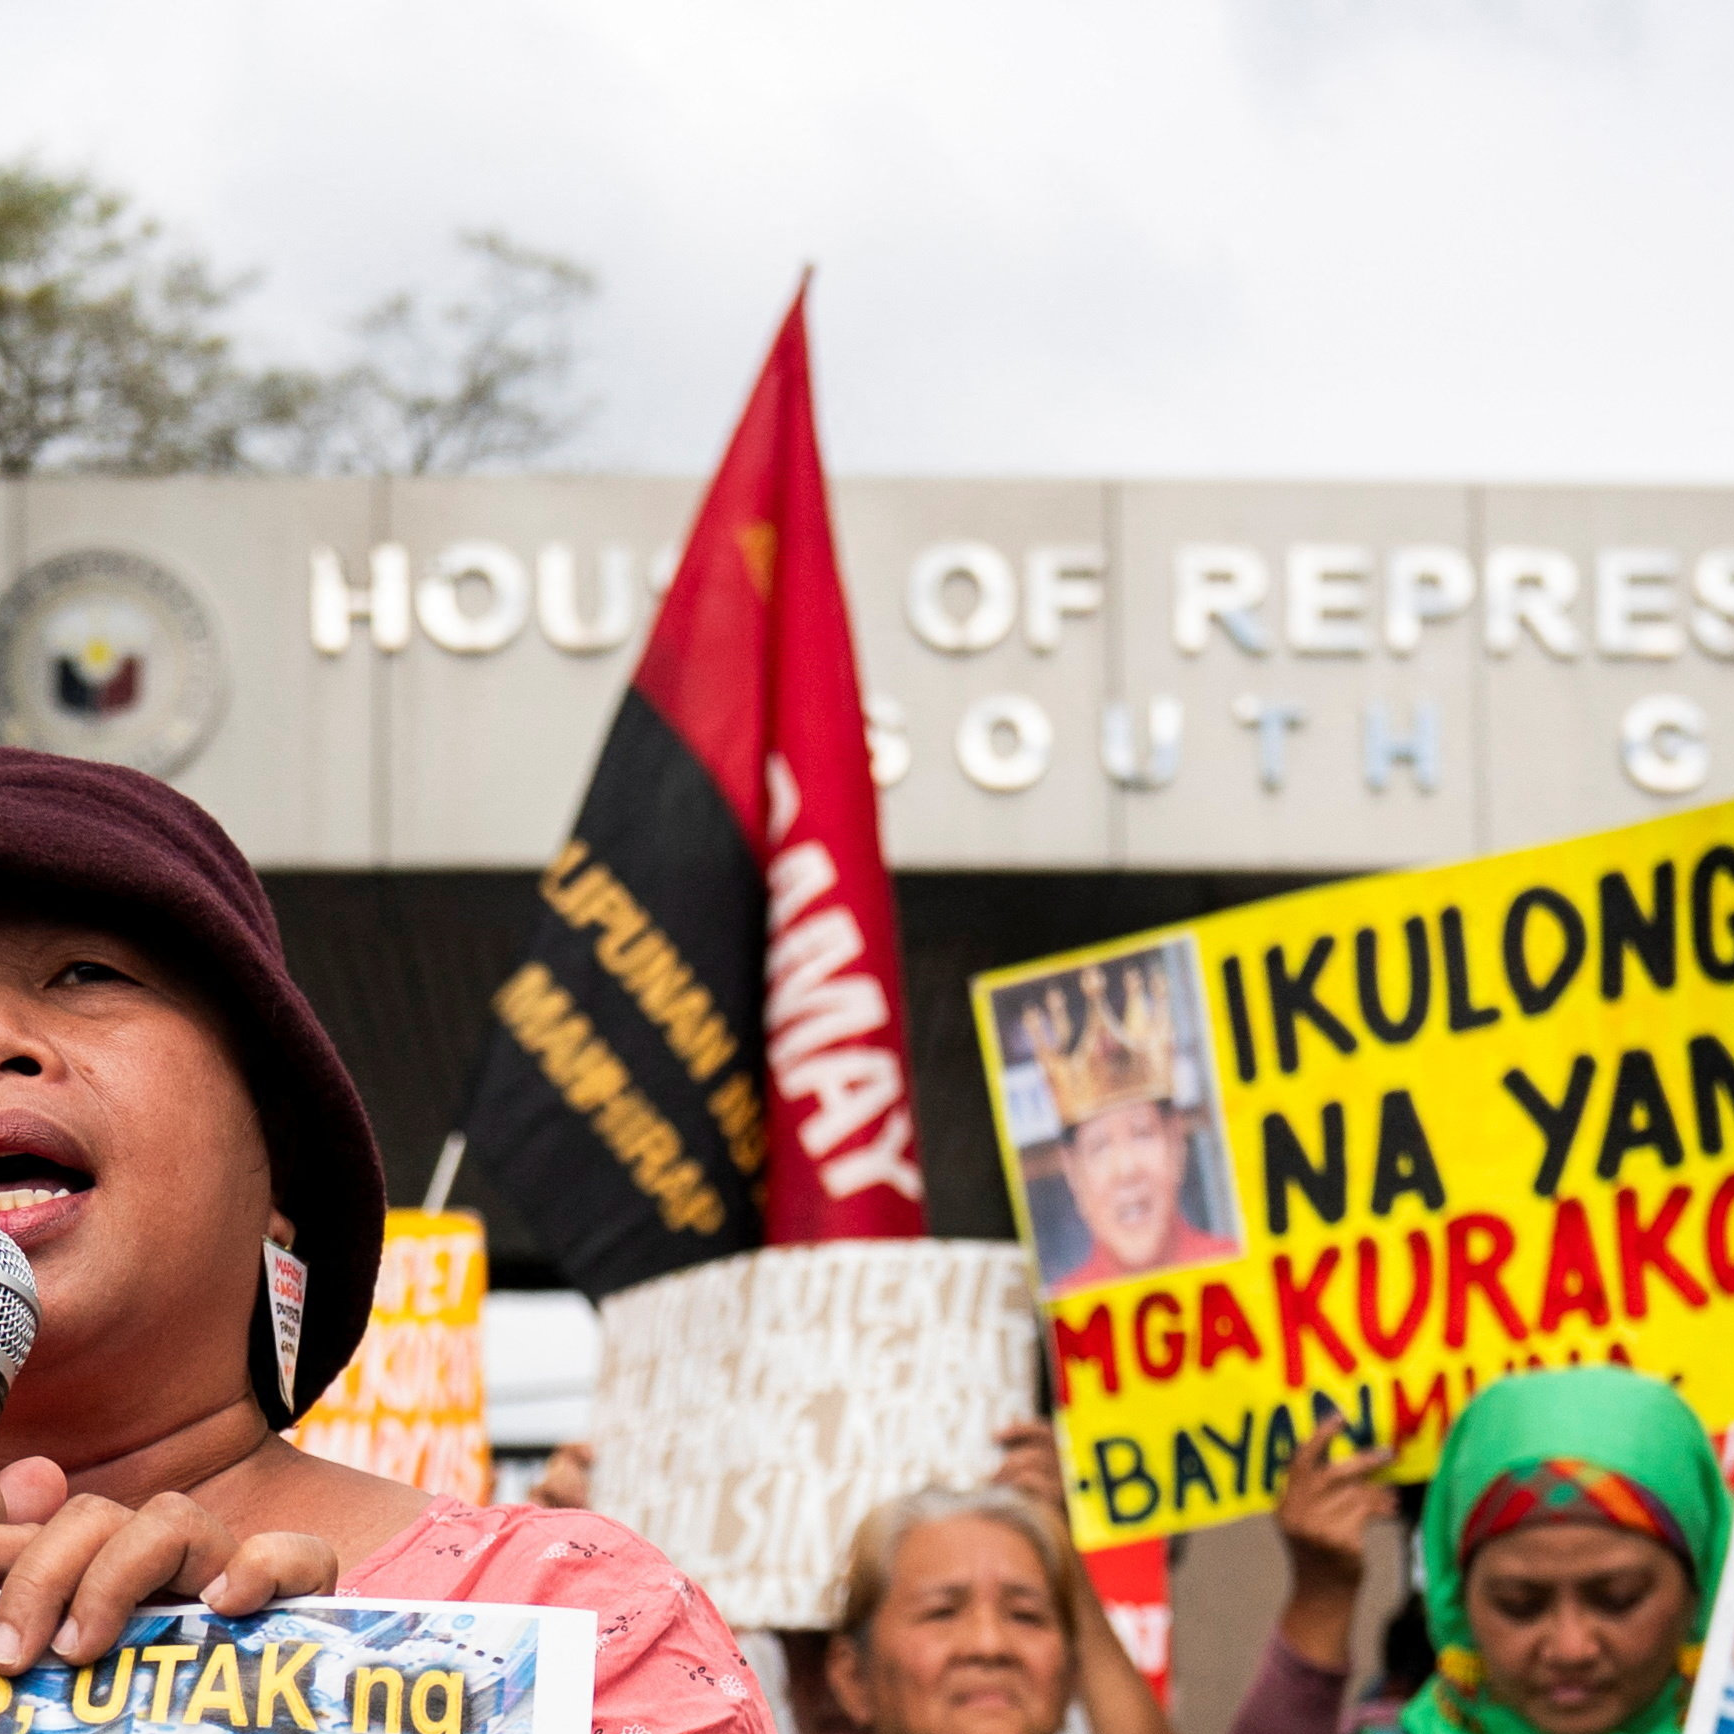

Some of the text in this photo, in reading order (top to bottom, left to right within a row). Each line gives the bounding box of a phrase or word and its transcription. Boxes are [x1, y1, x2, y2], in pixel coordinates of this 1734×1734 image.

[310, 541, 669, 656] HOU
[908, 541, 1106, 658] OF
[1261, 1088, 1446, 1238] NA
[1052, 1279, 1262, 1408] MGA
[70, 1641, 324, 1732] UTAK
